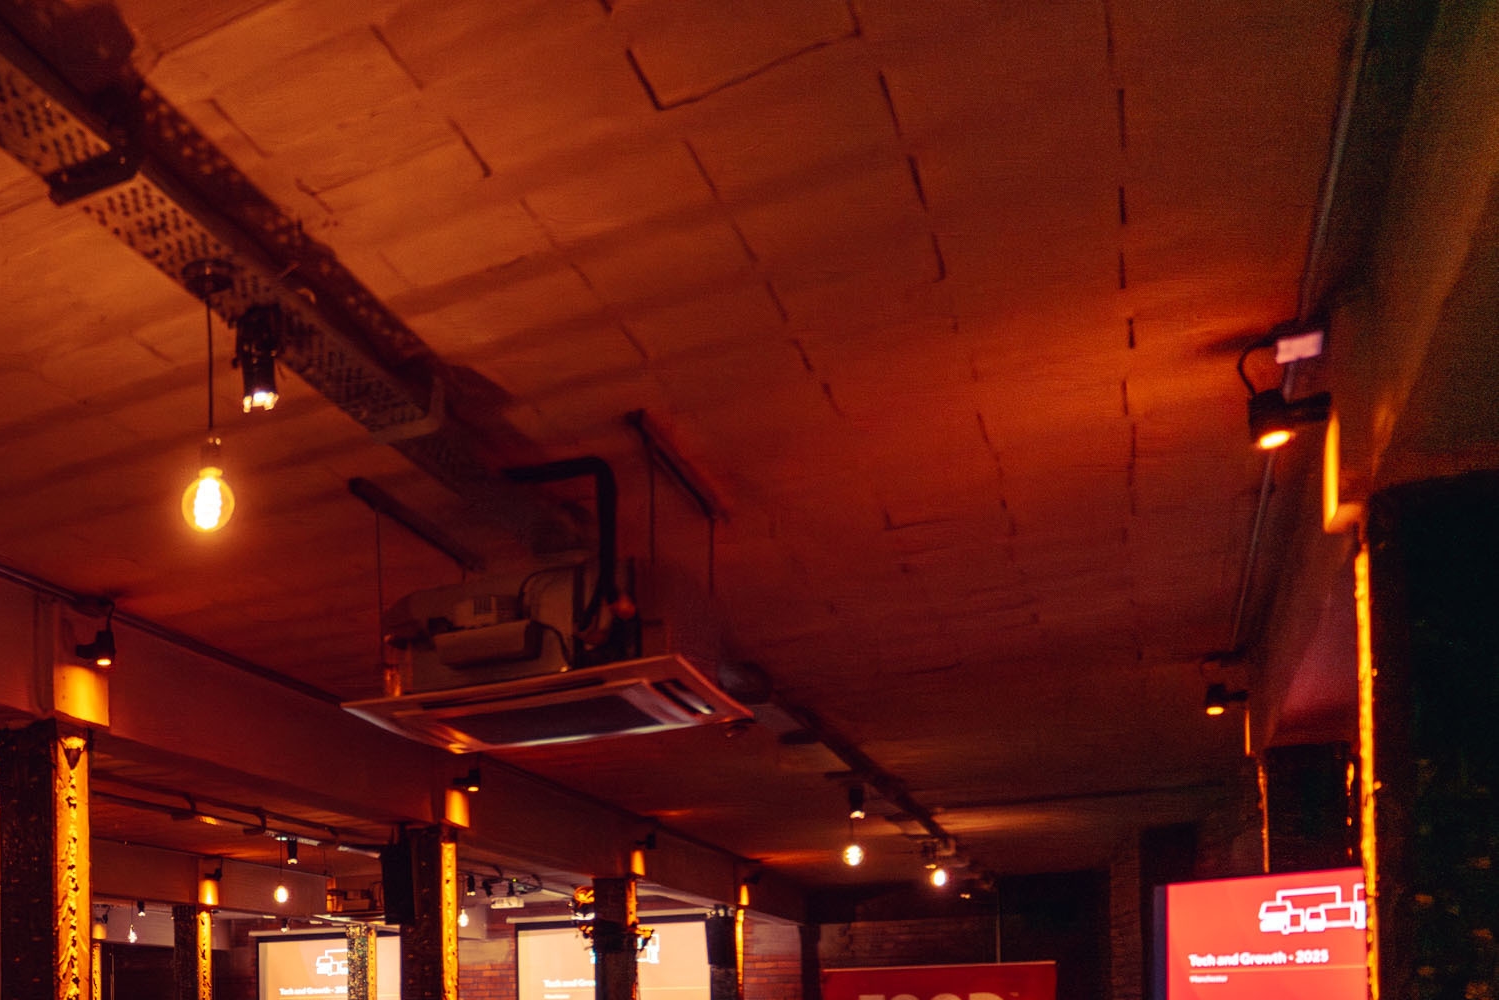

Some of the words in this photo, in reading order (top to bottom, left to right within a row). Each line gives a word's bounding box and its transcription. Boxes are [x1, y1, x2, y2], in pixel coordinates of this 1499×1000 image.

[1189, 953, 1216, 967] Tech
[1216, 953, 1239, 966] and
[1239, 951, 1287, 966] Growth
[1295, 949, 1329, 964] 2025
